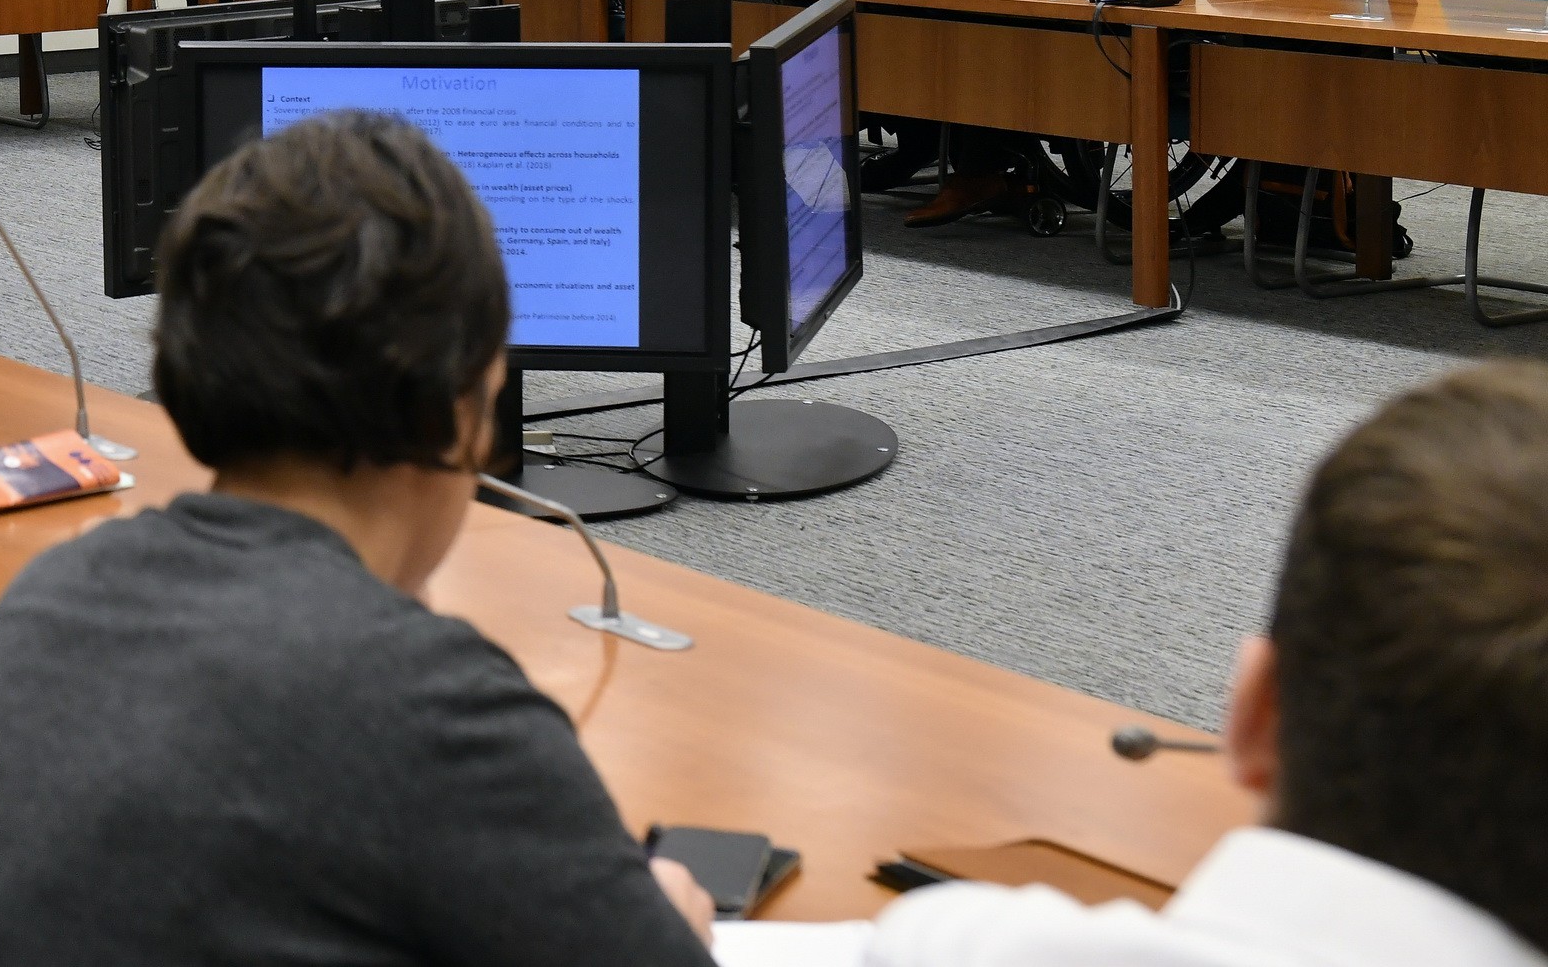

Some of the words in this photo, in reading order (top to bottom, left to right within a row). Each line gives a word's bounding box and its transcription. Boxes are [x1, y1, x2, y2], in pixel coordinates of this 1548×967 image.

[402, 75, 496, 90] Motivation
[457, 150, 516, 159] Heterogeneous
[520, 184, 543, 192] (asset
[545, 184, 572, 192] prices)
